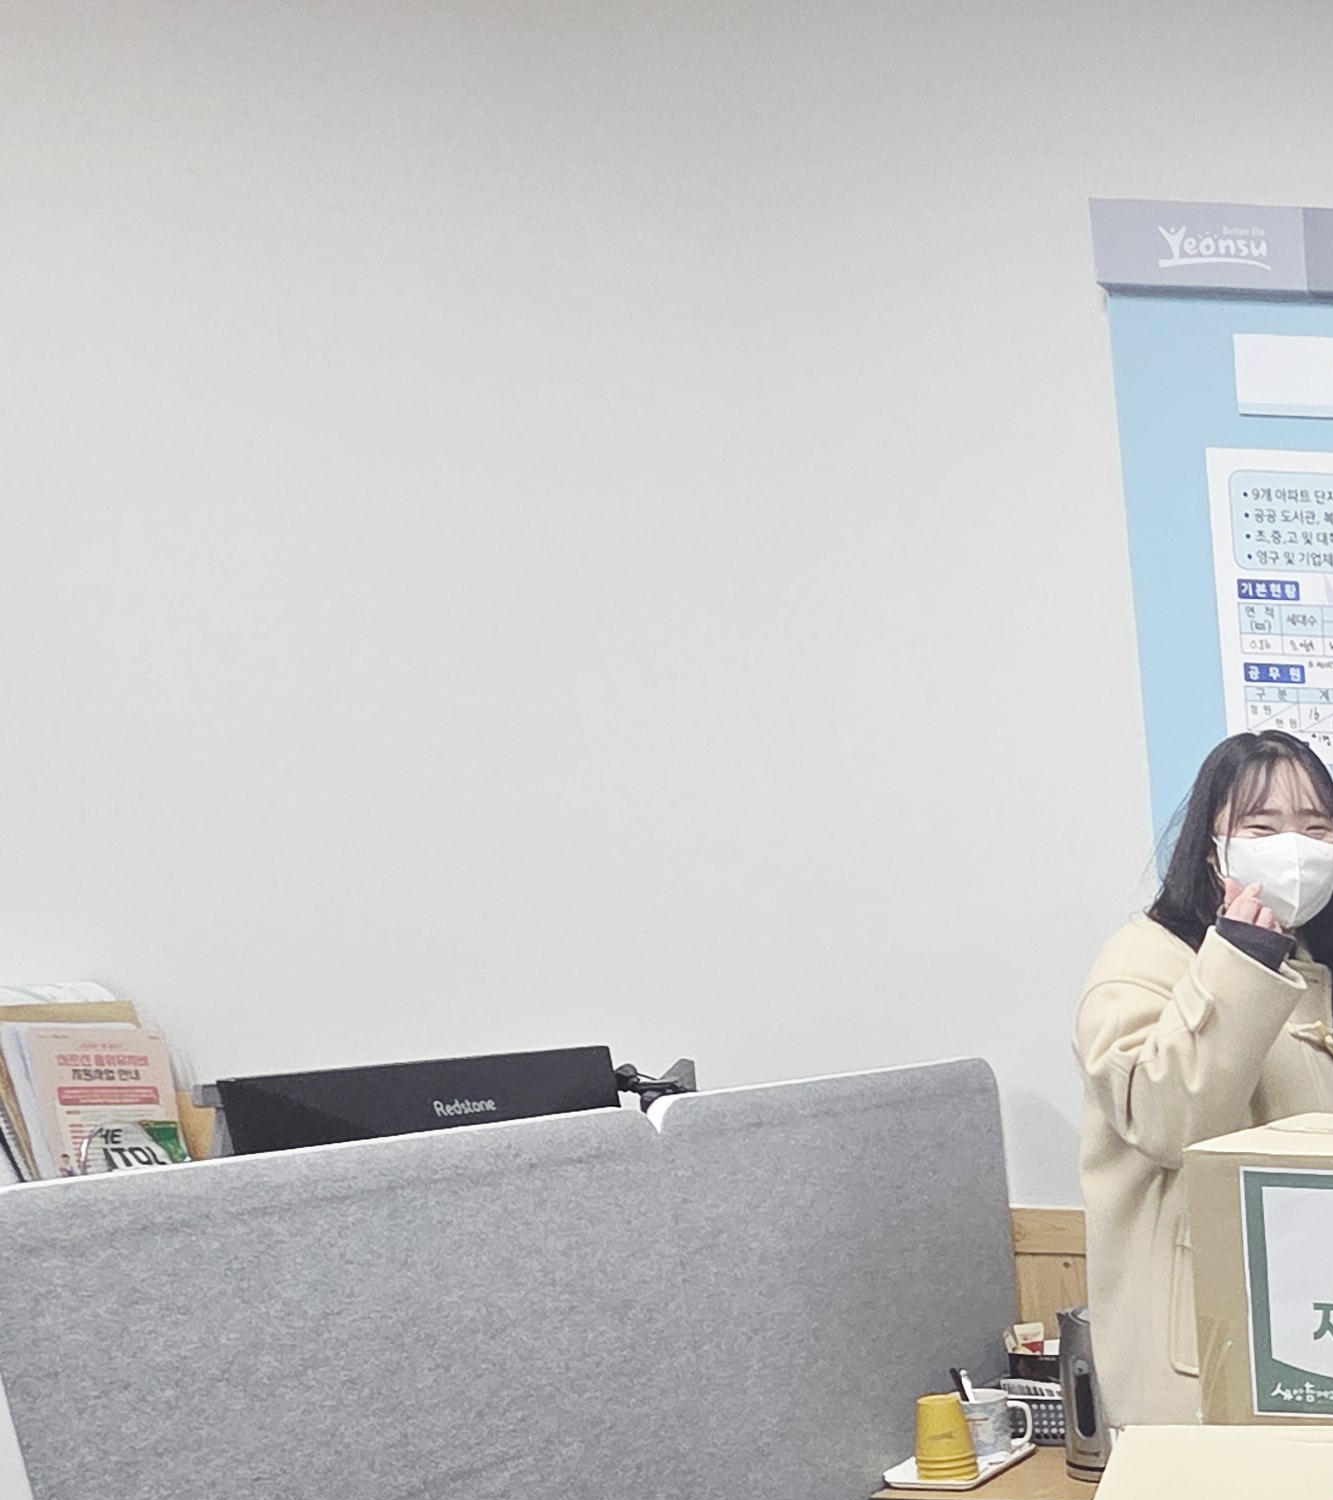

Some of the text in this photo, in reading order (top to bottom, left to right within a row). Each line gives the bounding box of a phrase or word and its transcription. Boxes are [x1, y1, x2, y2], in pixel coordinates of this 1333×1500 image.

[1158, 225, 1267, 260] Yeonsu
[1251, 488, 1271, 501] 9개
[1254, 509, 1276, 523] 공공
[1302, 532, 1312, 545] 및
[1284, 552, 1294, 565] 및
[1240, 582, 1297, 599] 기본현황
[433, 1099, 497, 1117] Redstone
